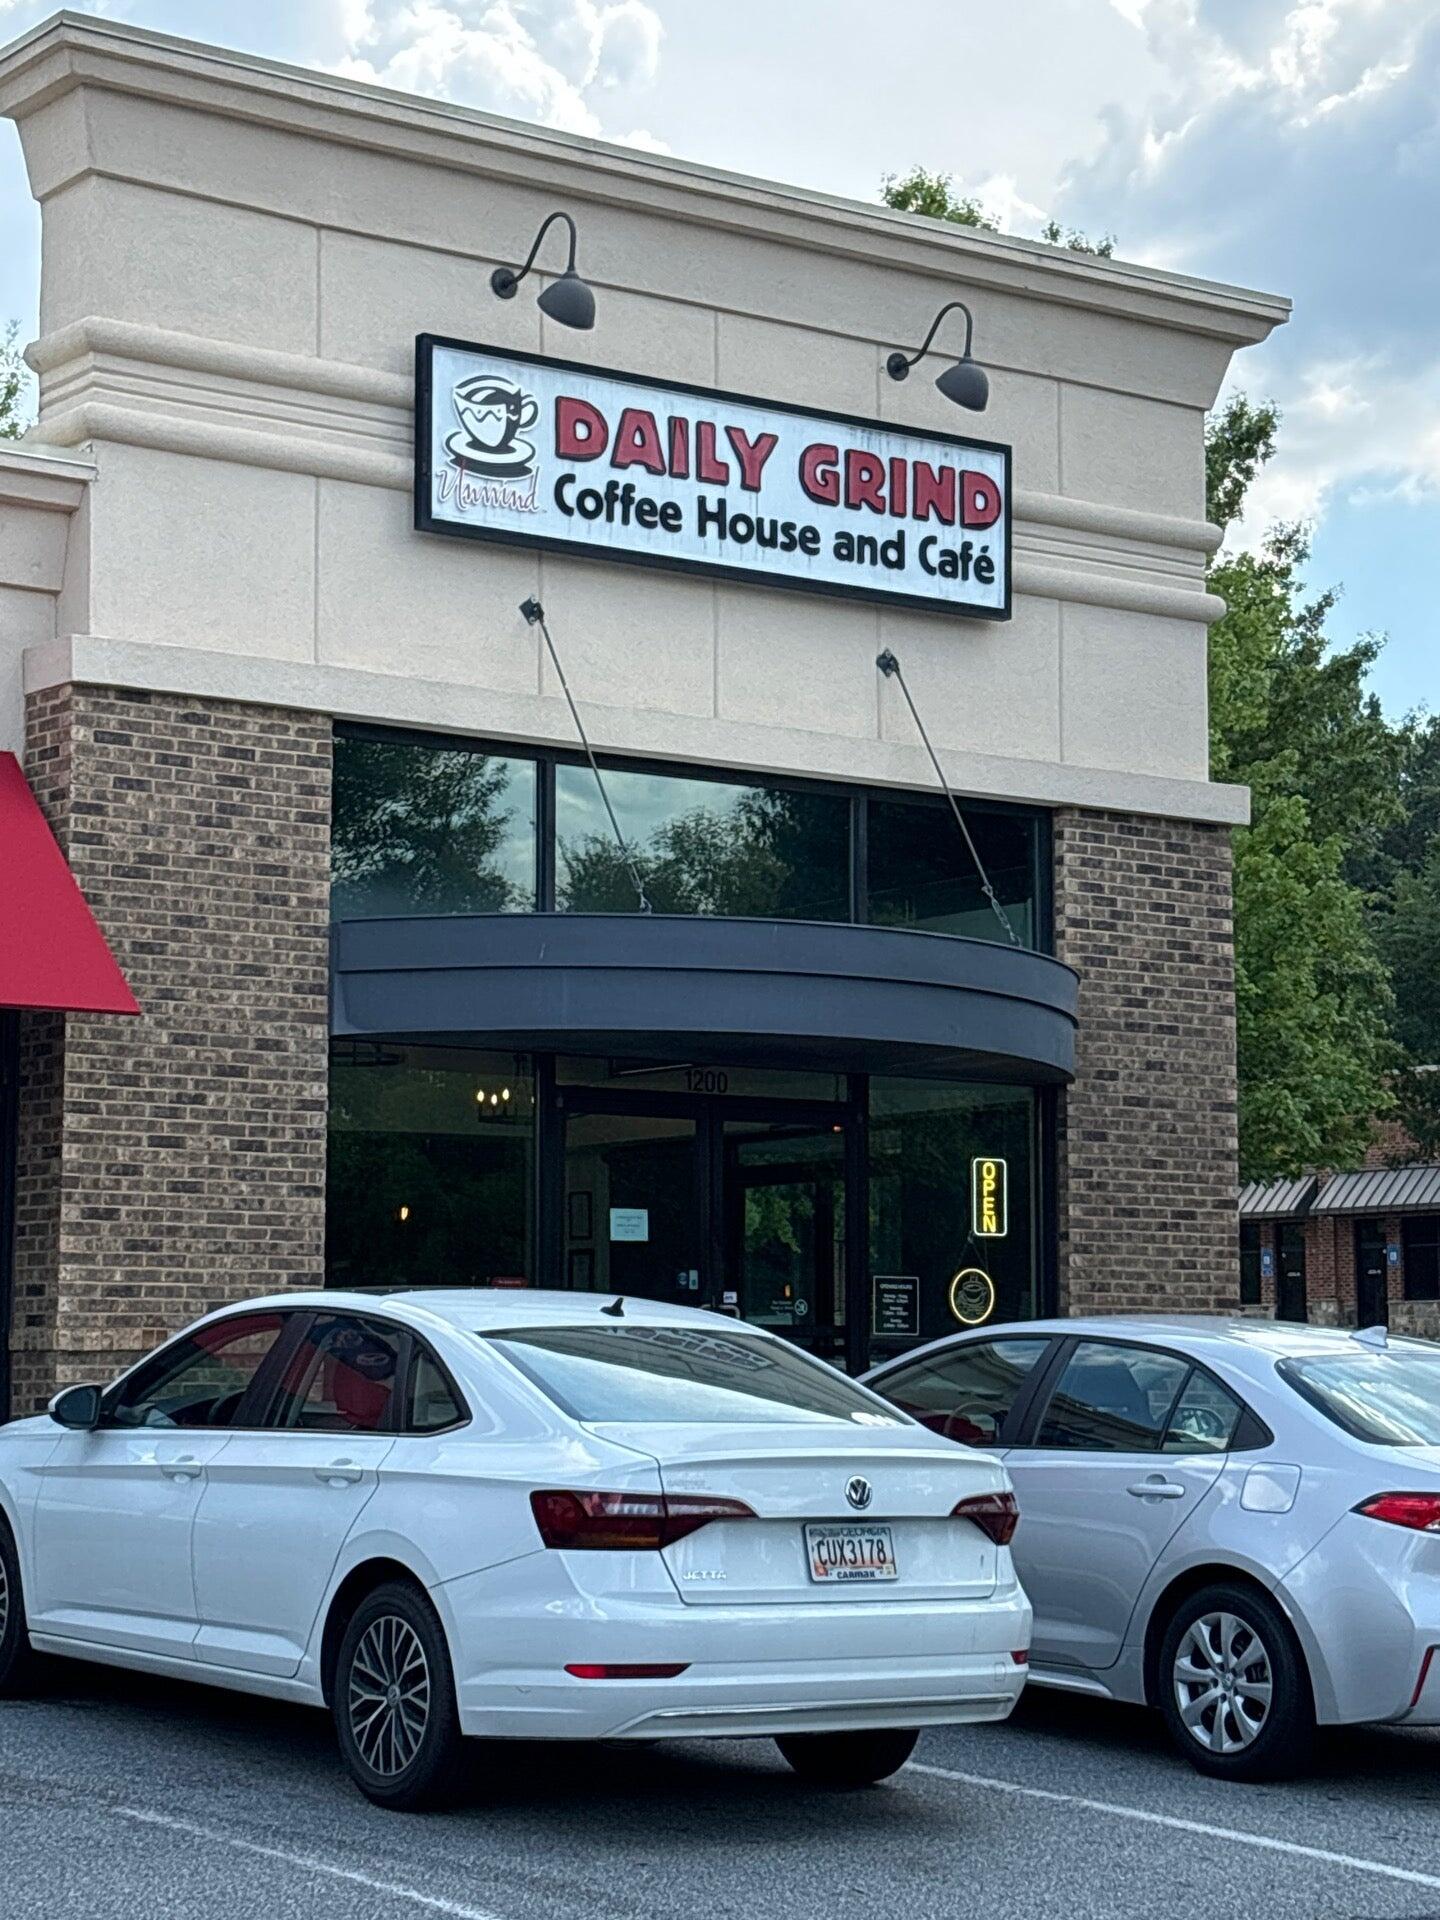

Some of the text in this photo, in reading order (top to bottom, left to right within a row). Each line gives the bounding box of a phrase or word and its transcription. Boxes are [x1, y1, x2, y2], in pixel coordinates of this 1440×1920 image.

[554, 396, 1002, 530] DAILY GRIND
[553, 473, 996, 585] Coffee House and Café
[685, 1069, 728, 1093] 1200
[982, 1161, 997, 1233] OPEN
[682, 1570, 727, 1580] JETTA
[815, 1538, 887, 1566] CUX3178
